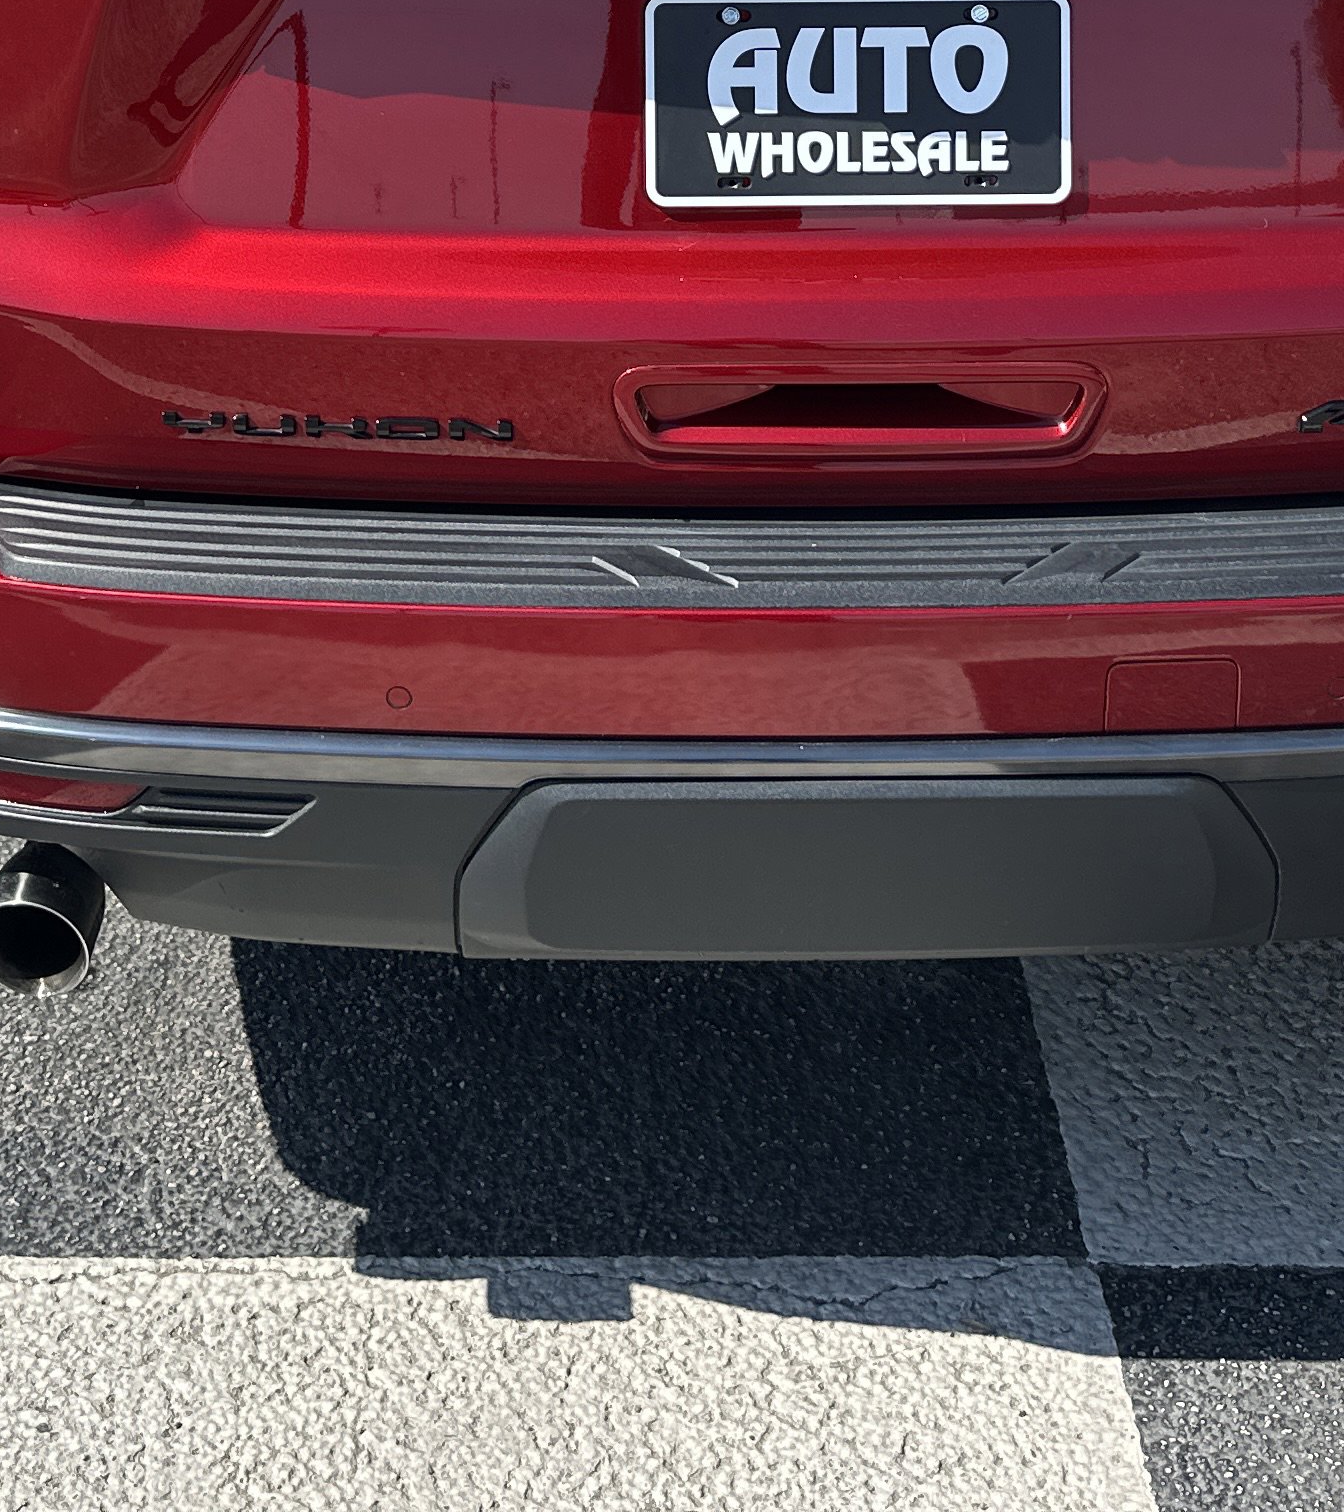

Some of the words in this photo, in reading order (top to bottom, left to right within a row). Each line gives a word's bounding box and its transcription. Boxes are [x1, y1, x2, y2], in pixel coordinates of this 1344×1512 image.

[707, 24, 1009, 126] AUTO
[707, 129, 1010, 178] WHOLESALE
[162, 411, 514, 441] YUKON
